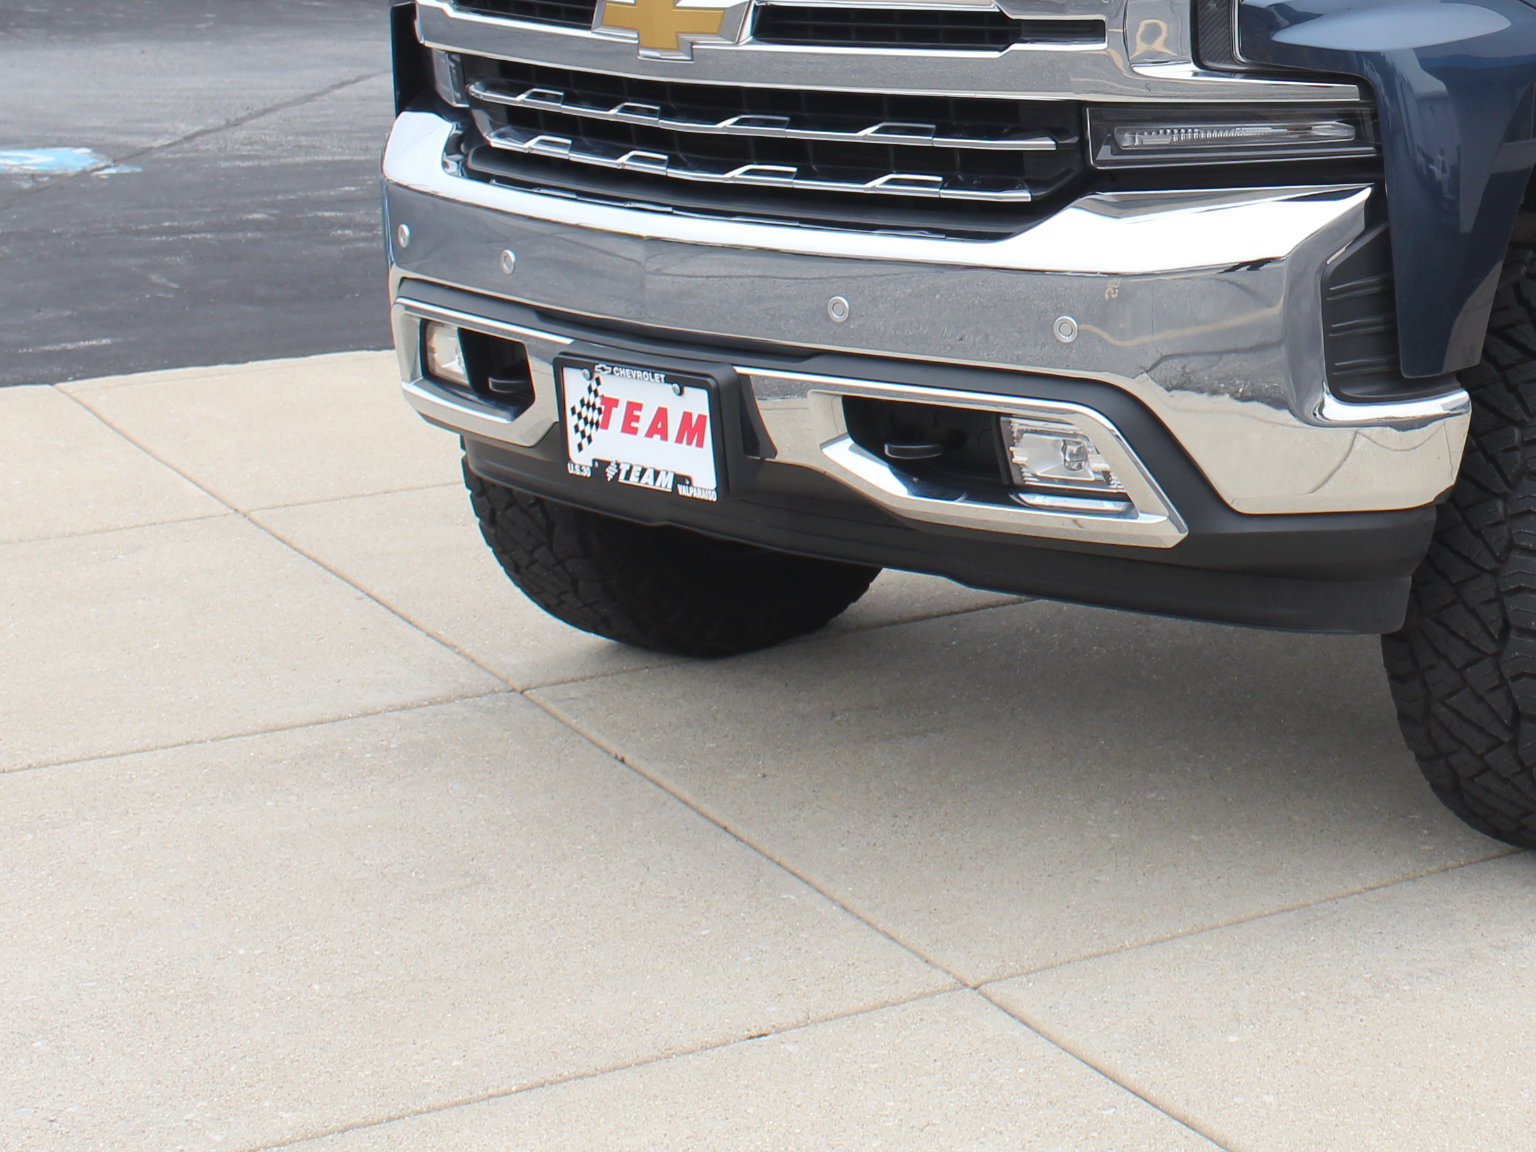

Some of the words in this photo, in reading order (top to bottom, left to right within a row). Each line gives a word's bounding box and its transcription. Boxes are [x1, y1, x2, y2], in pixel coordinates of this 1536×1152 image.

[613, 366, 666, 383] CHEVROLET
[600, 396, 707, 448] TEAM
[618, 462, 675, 490] TEAM
[677, 483, 717, 502] VALPARAISO
